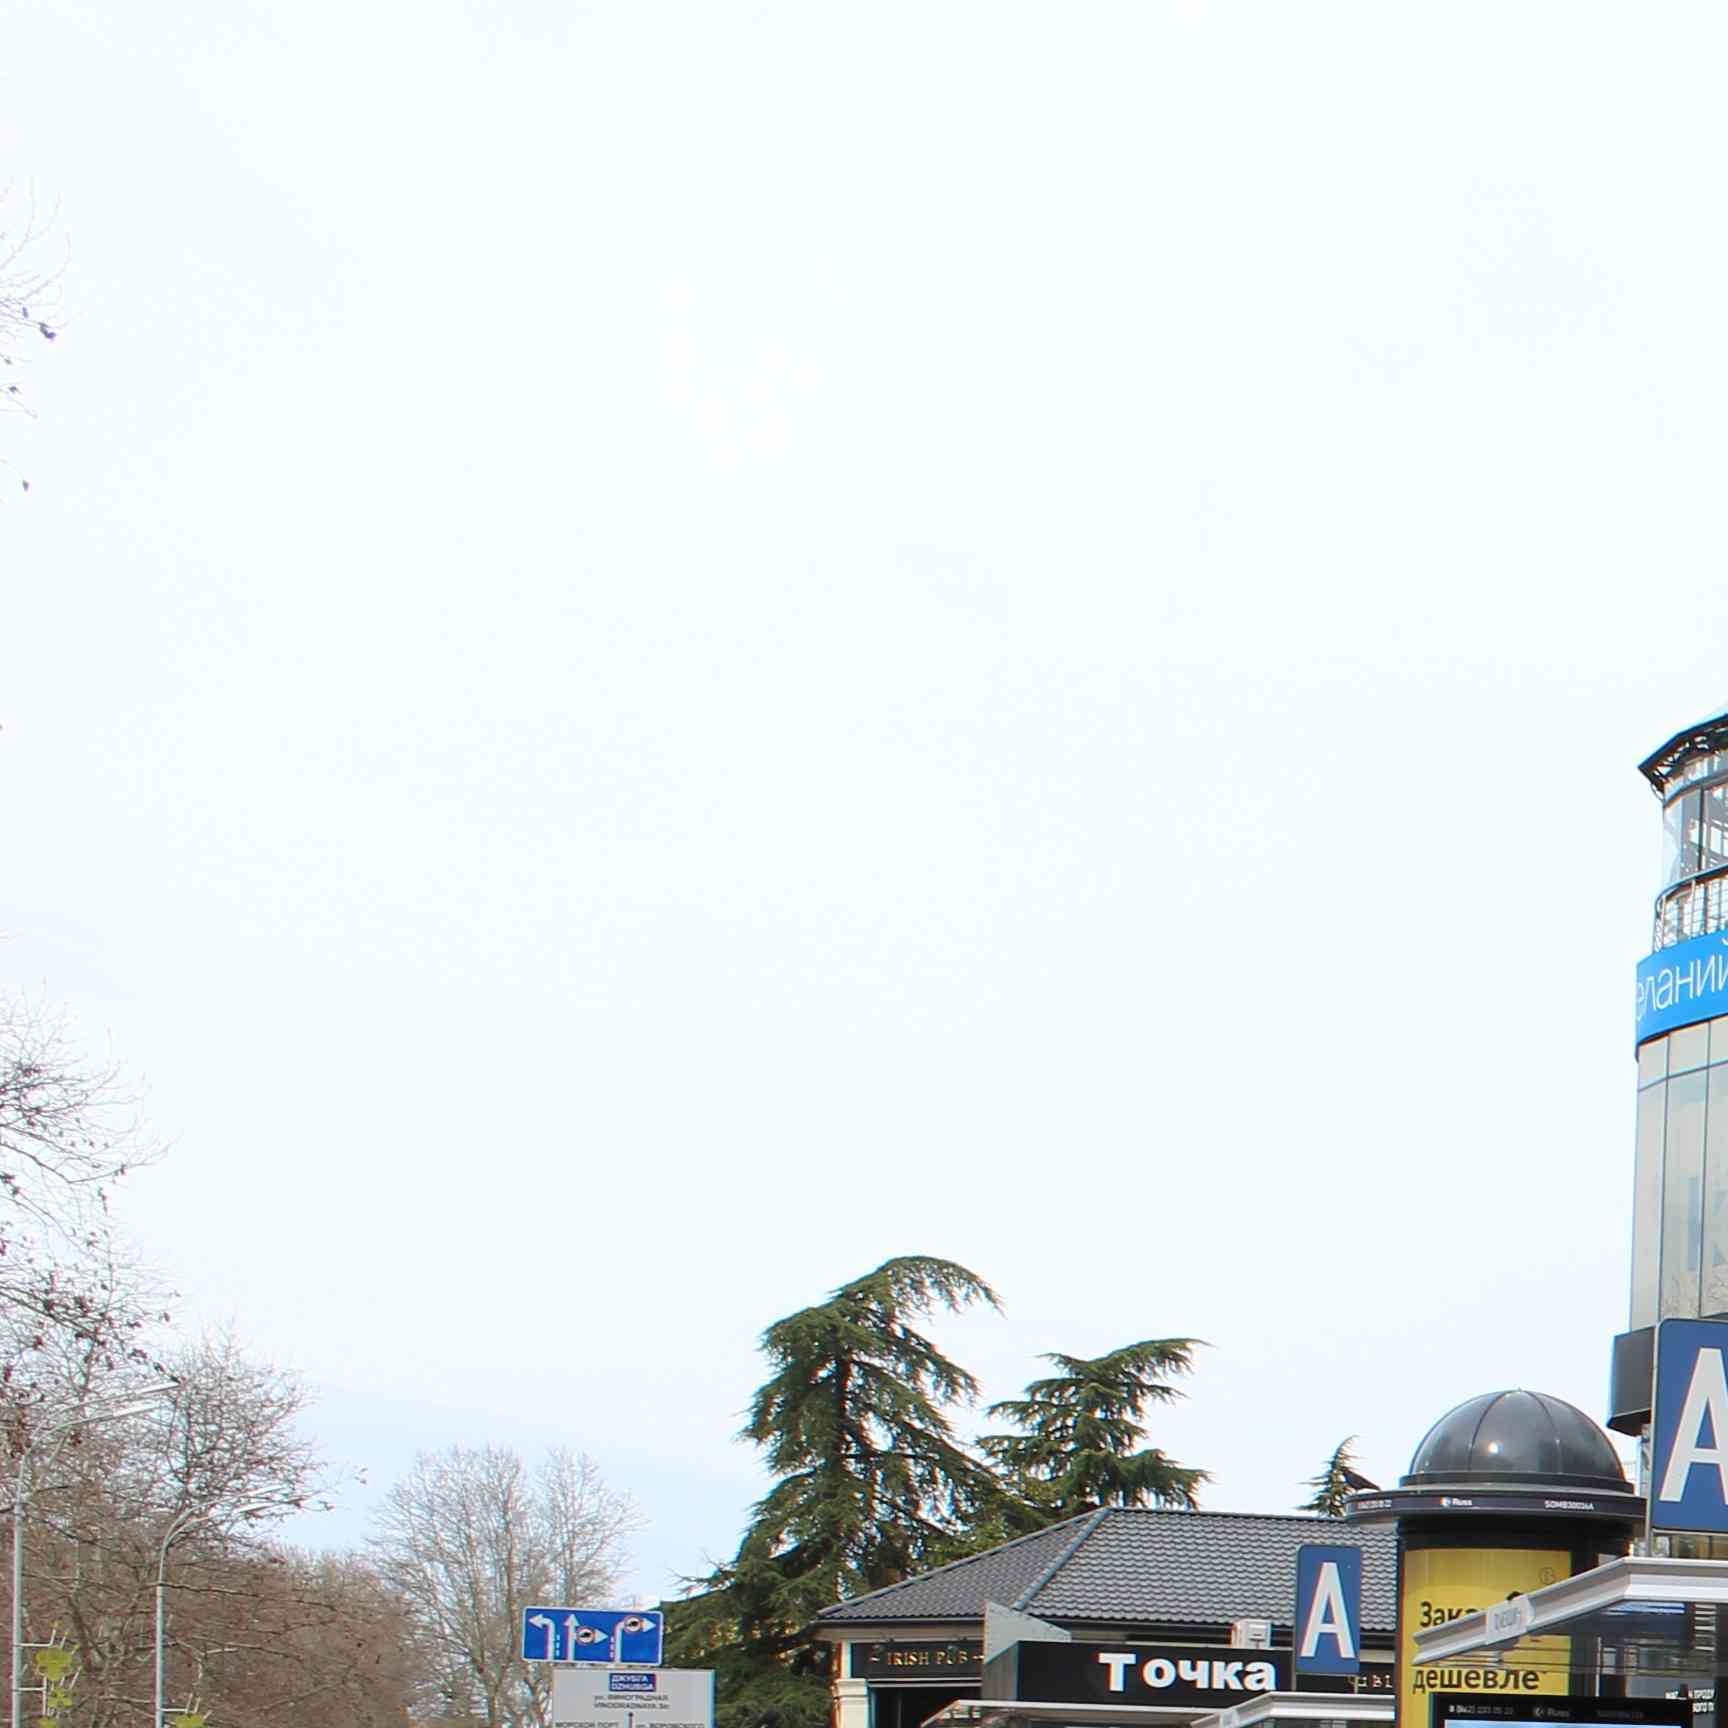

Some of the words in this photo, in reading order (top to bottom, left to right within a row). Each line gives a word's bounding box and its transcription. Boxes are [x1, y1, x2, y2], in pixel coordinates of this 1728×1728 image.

[887, 1651, 929, 1665] IRISH
[935, 1650, 968, 1665] PUB
[1099, 1652, 1277, 1692] Точка
[1412, 1669, 1540, 1695] дешевле
